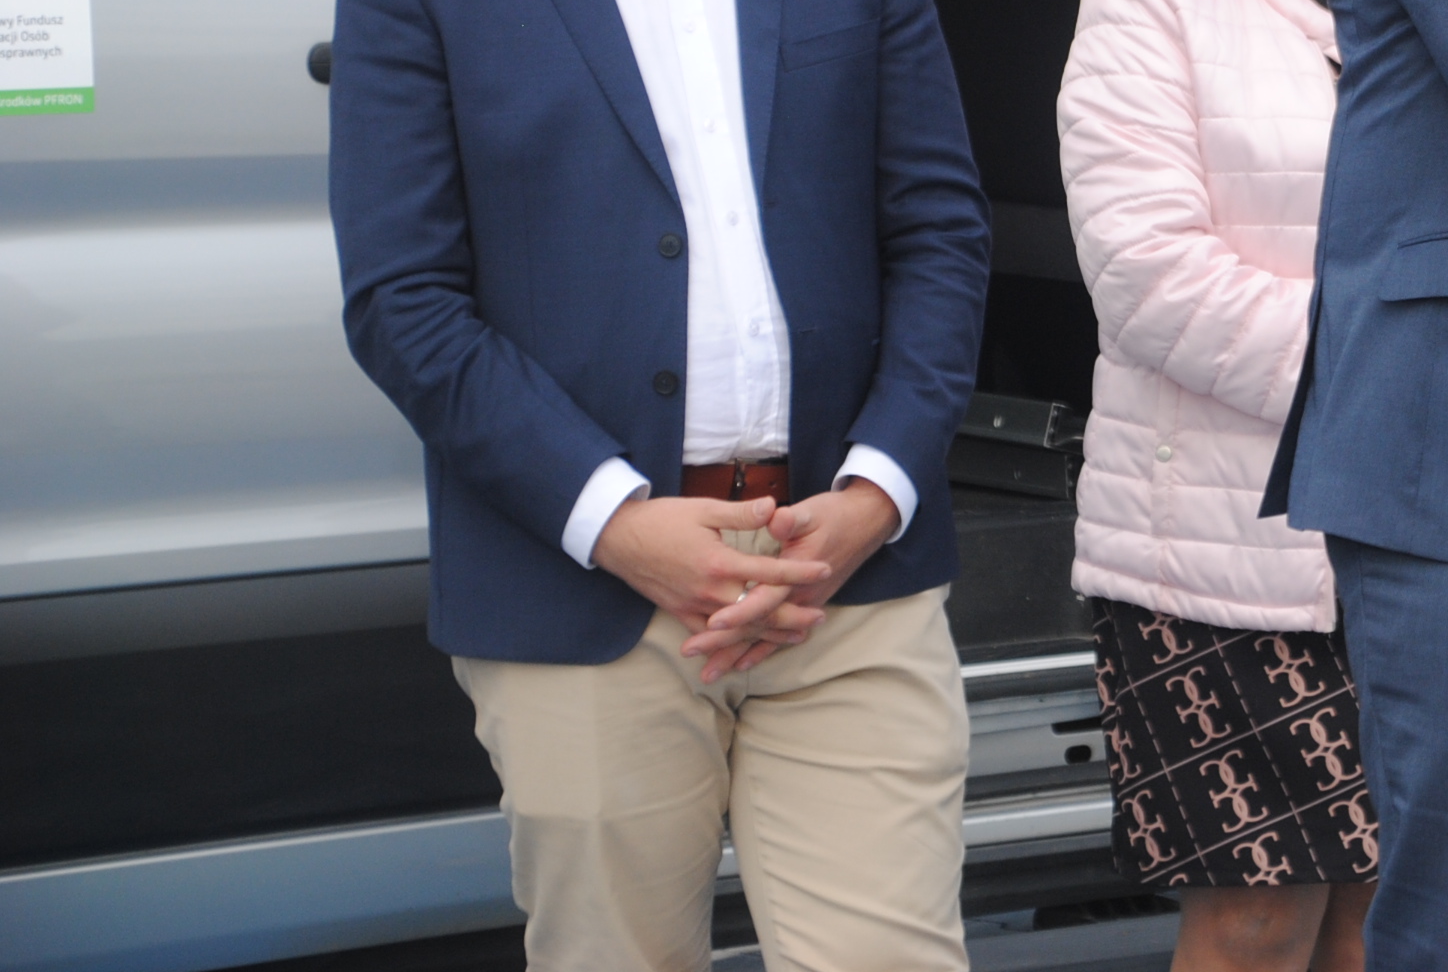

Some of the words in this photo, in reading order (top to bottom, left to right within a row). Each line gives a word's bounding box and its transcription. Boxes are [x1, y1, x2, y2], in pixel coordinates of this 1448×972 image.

[17, 15, 63, 26] Fundusz
[20, 30, 49, 42] Osób
[44, 94, 83, 105] PFRON
